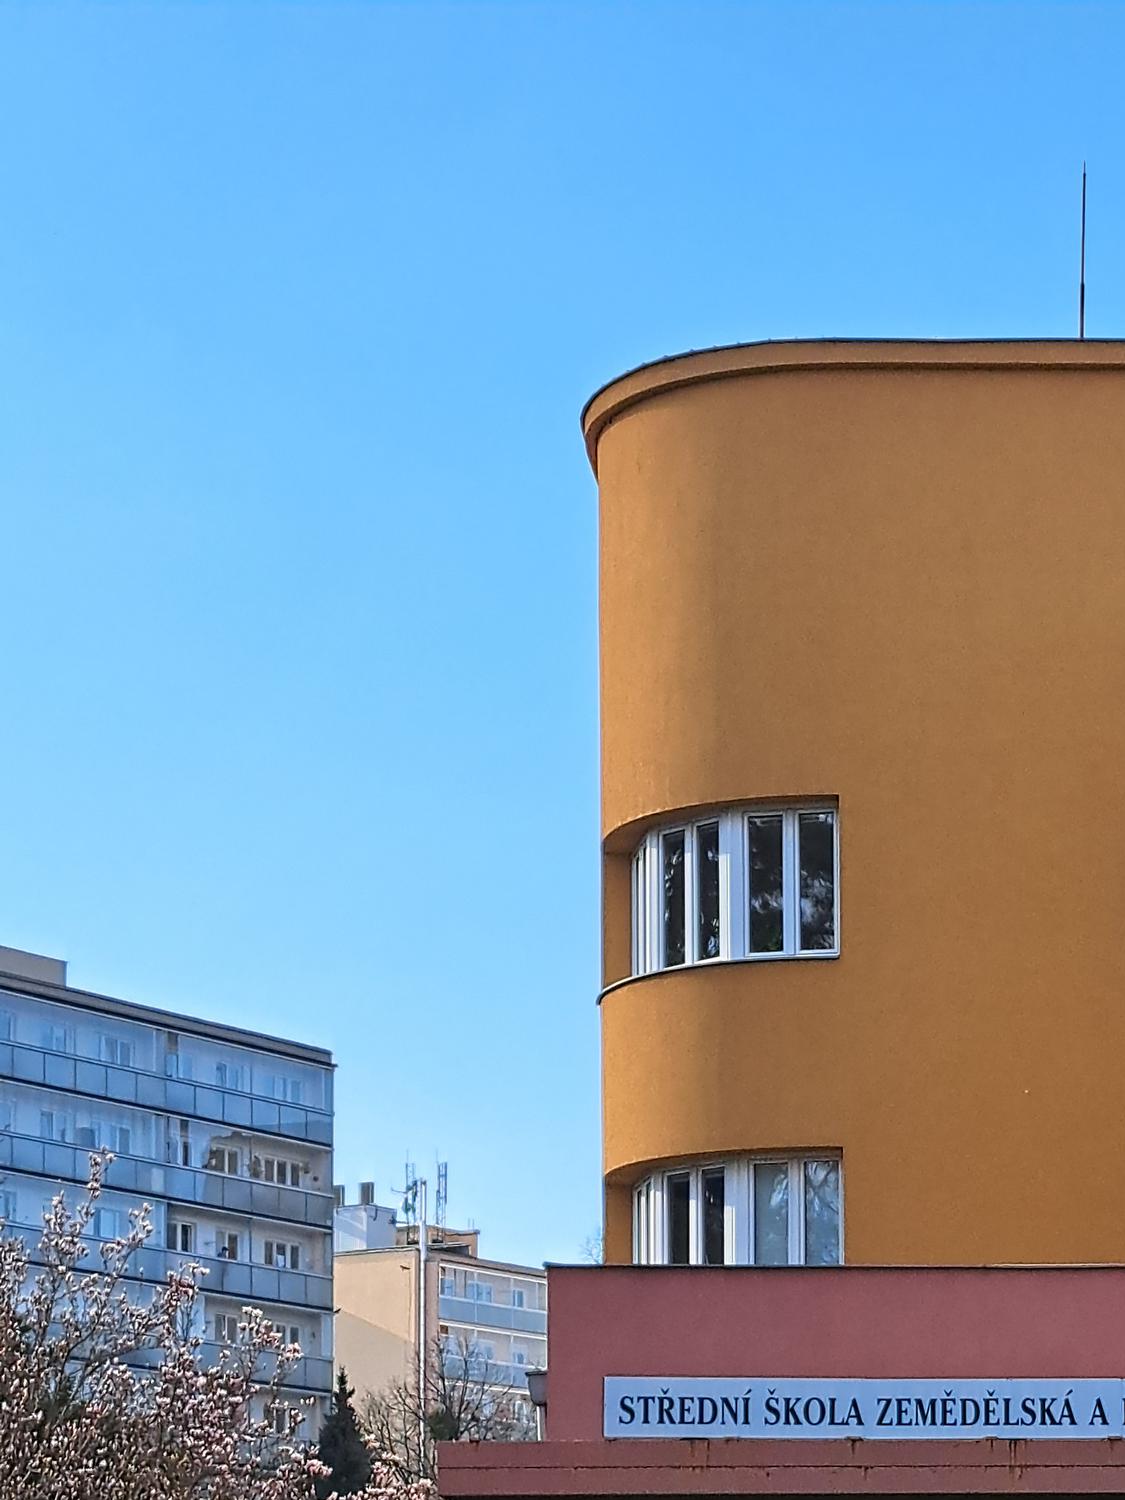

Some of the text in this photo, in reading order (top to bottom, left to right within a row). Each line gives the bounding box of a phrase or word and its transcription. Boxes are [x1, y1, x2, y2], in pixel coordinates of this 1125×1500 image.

[618, 1388, 752, 1426] STŘEDNÍ
[763, 1388, 864, 1426] ŠKOLA
[876, 1389, 1077, 1427] ZEMĚDĚLSKÁ
[1089, 1396, 1109, 1426] A
